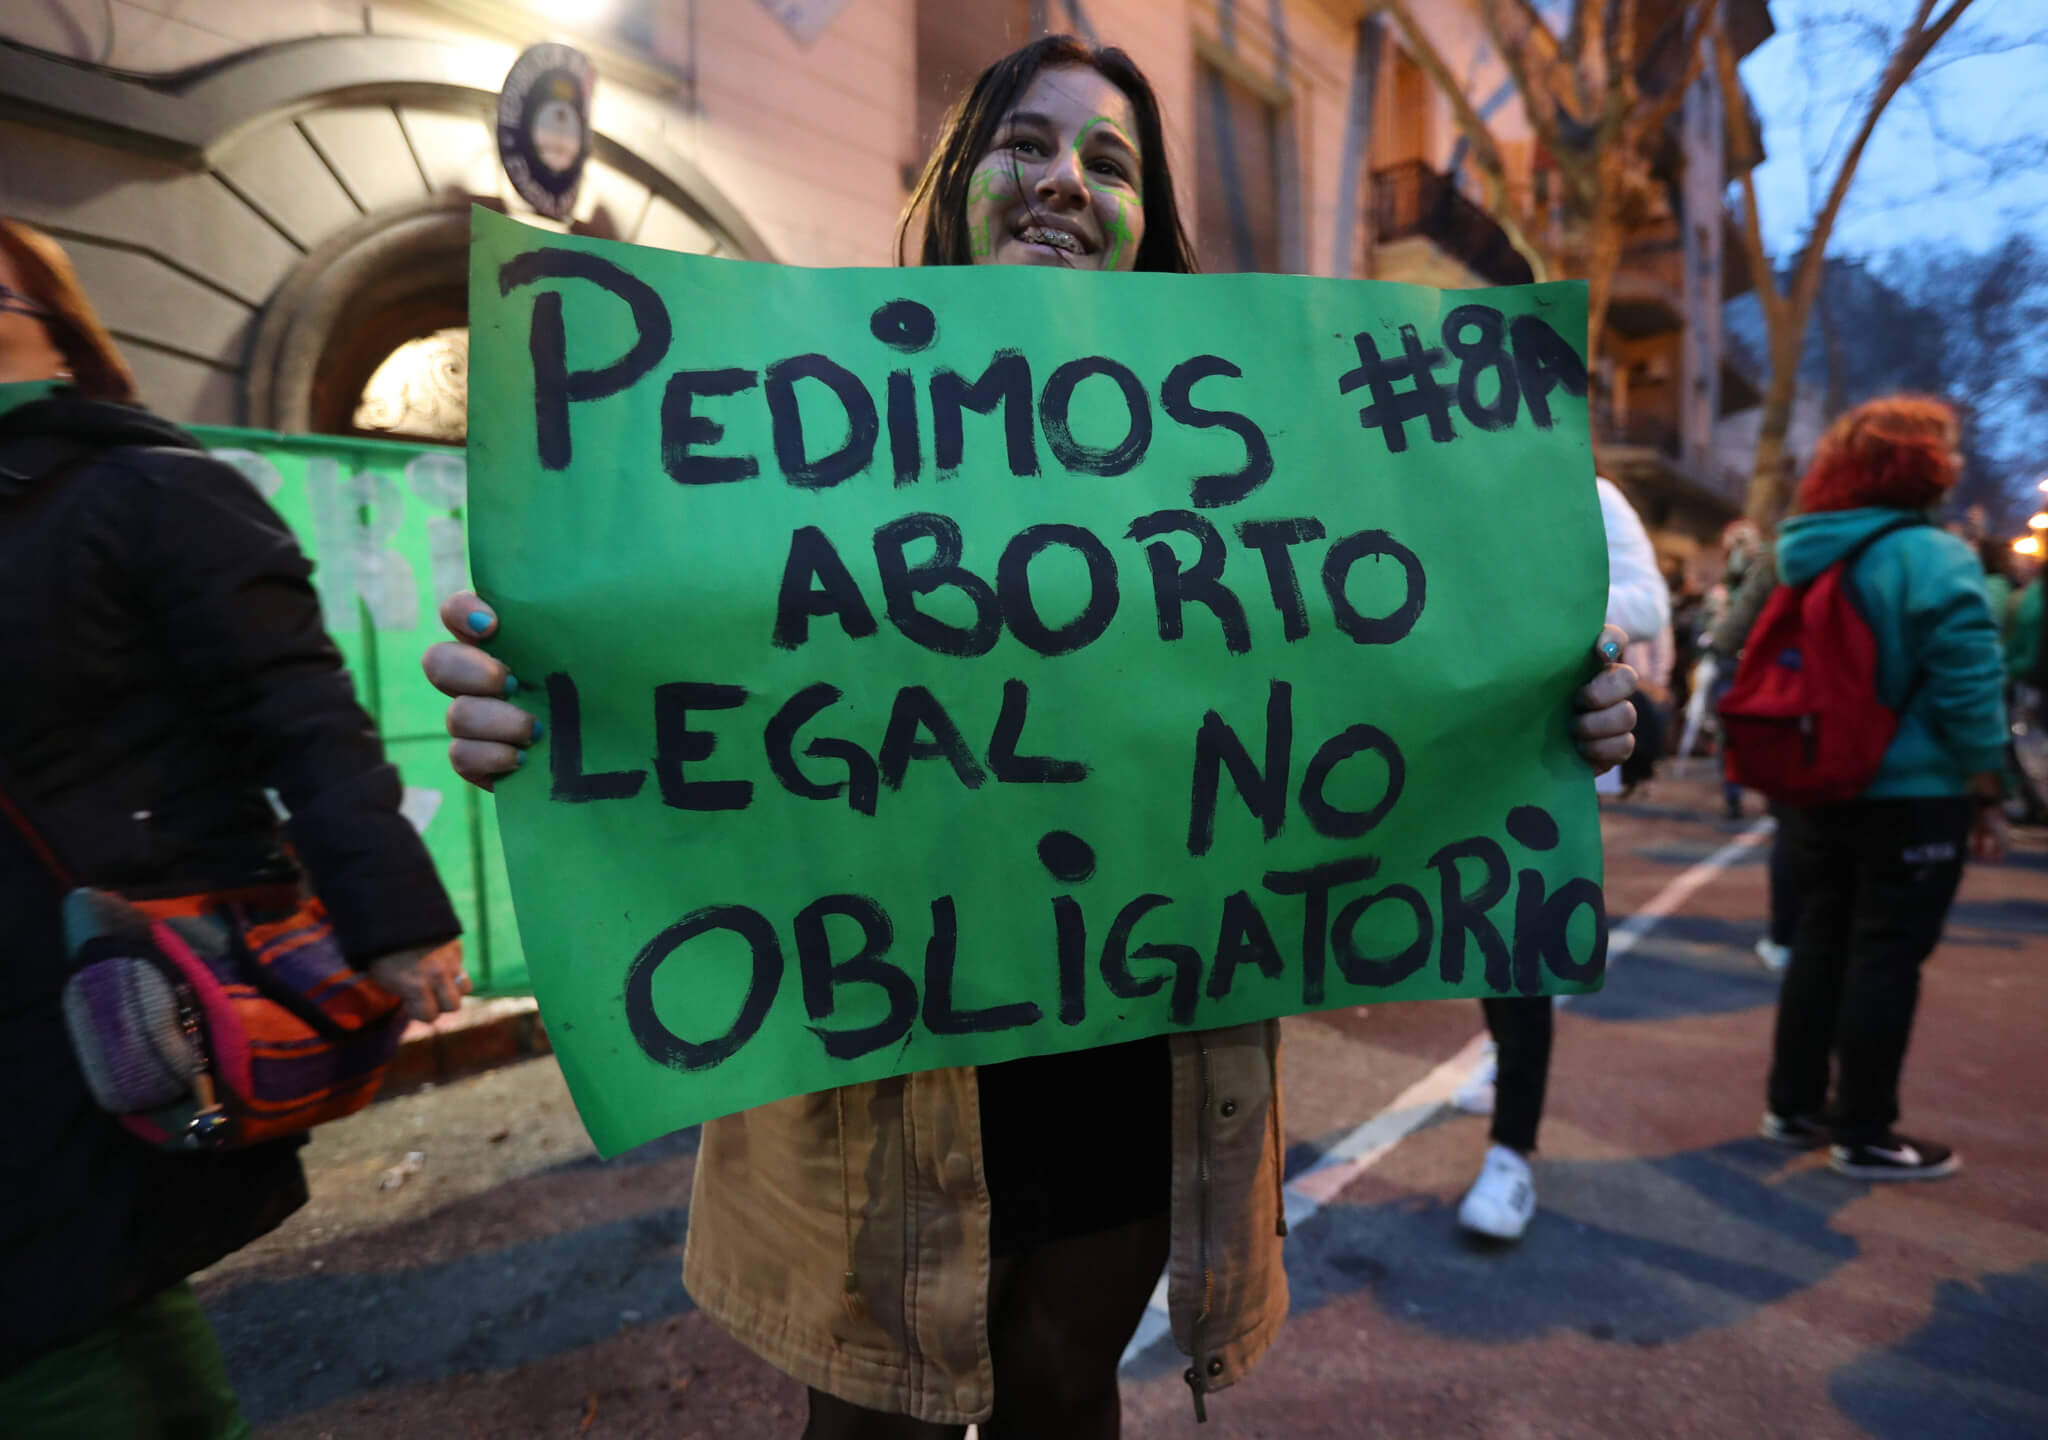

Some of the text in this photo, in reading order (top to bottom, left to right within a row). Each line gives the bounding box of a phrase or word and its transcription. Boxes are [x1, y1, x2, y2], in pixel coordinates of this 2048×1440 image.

[1339, 303, 1588, 454] #8A
[771, 509, 1427, 658] ABORTO
[545, 671, 1406, 857] LEGAL NO
